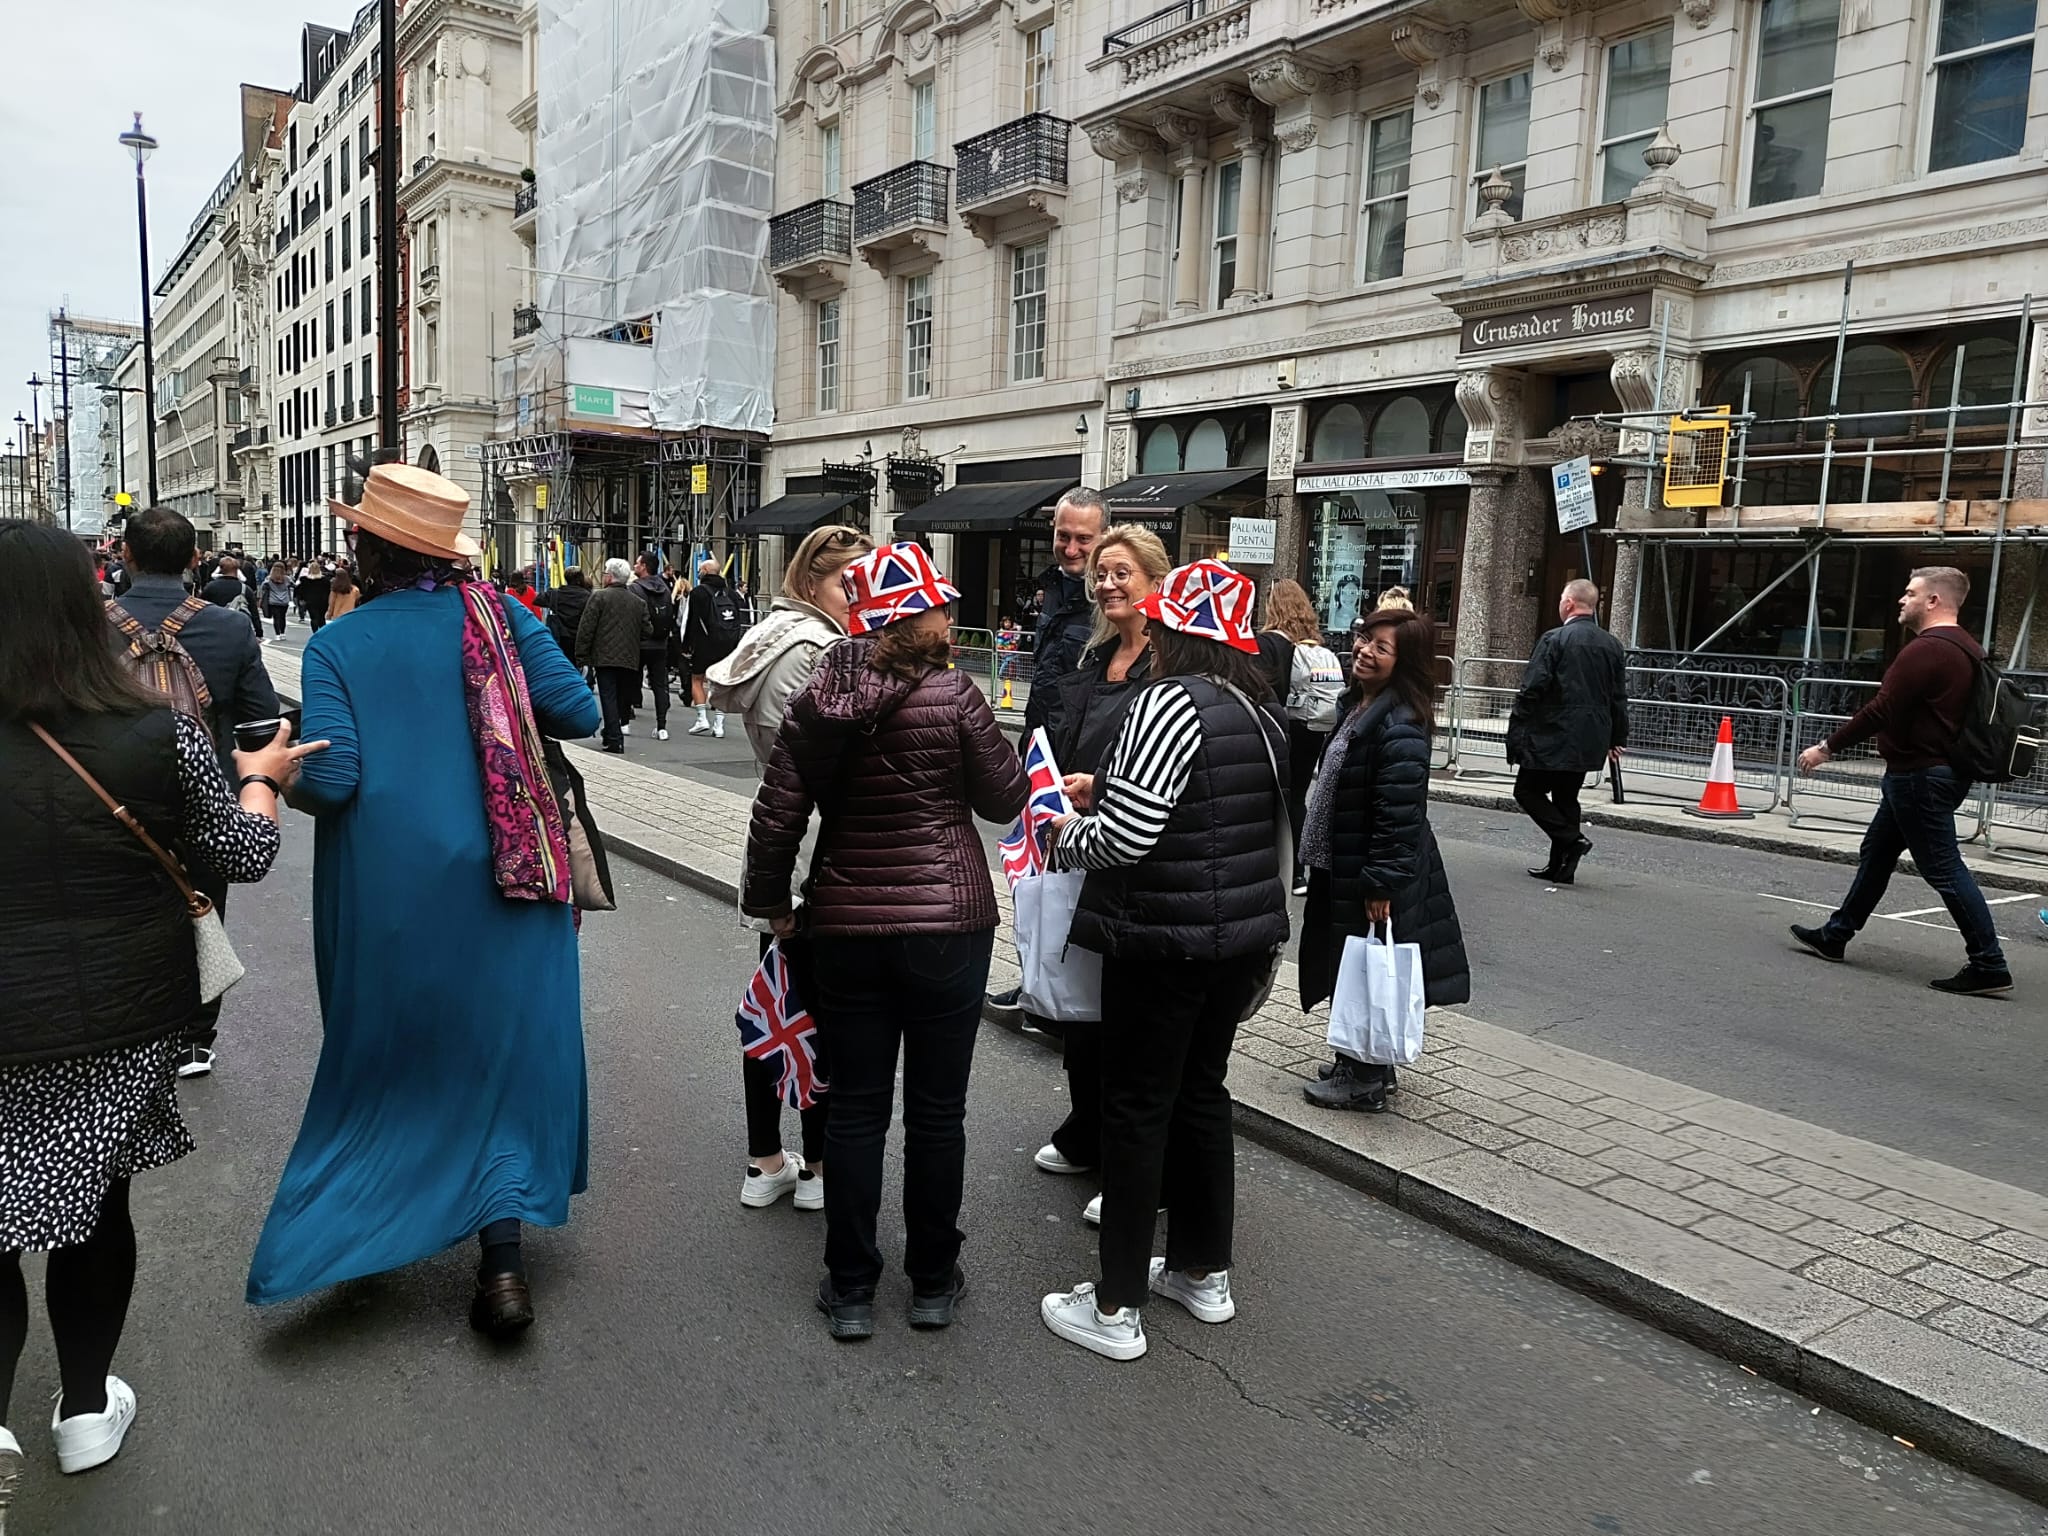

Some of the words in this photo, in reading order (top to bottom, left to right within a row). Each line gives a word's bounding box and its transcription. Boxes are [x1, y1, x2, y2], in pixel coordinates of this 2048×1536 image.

[1473, 315, 1562, 345] Crusader
[1571, 303, 1635, 332] House
[579, 394, 611, 406] HARTE
[1300, 479, 1321, 489] PALL
[1322, 476, 1345, 488] MALL
[1349, 474, 1385, 486] DENTAL
[1401, 472, 1419, 484] 020
[1422, 471, 1445, 482] 7766
[1341, 507, 1369, 520] MALL
[1374, 505, 1419, 519] DENTAL
[1231, 522, 1249, 533] PALL
[1252, 523, 1273, 534] MALL
[1237, 535, 1269, 546] DENTAL
[1230, 550, 1242, 559] 020
[1242, 551, 1258, 559] 7766
[1258, 552, 1274, 560] 7150
